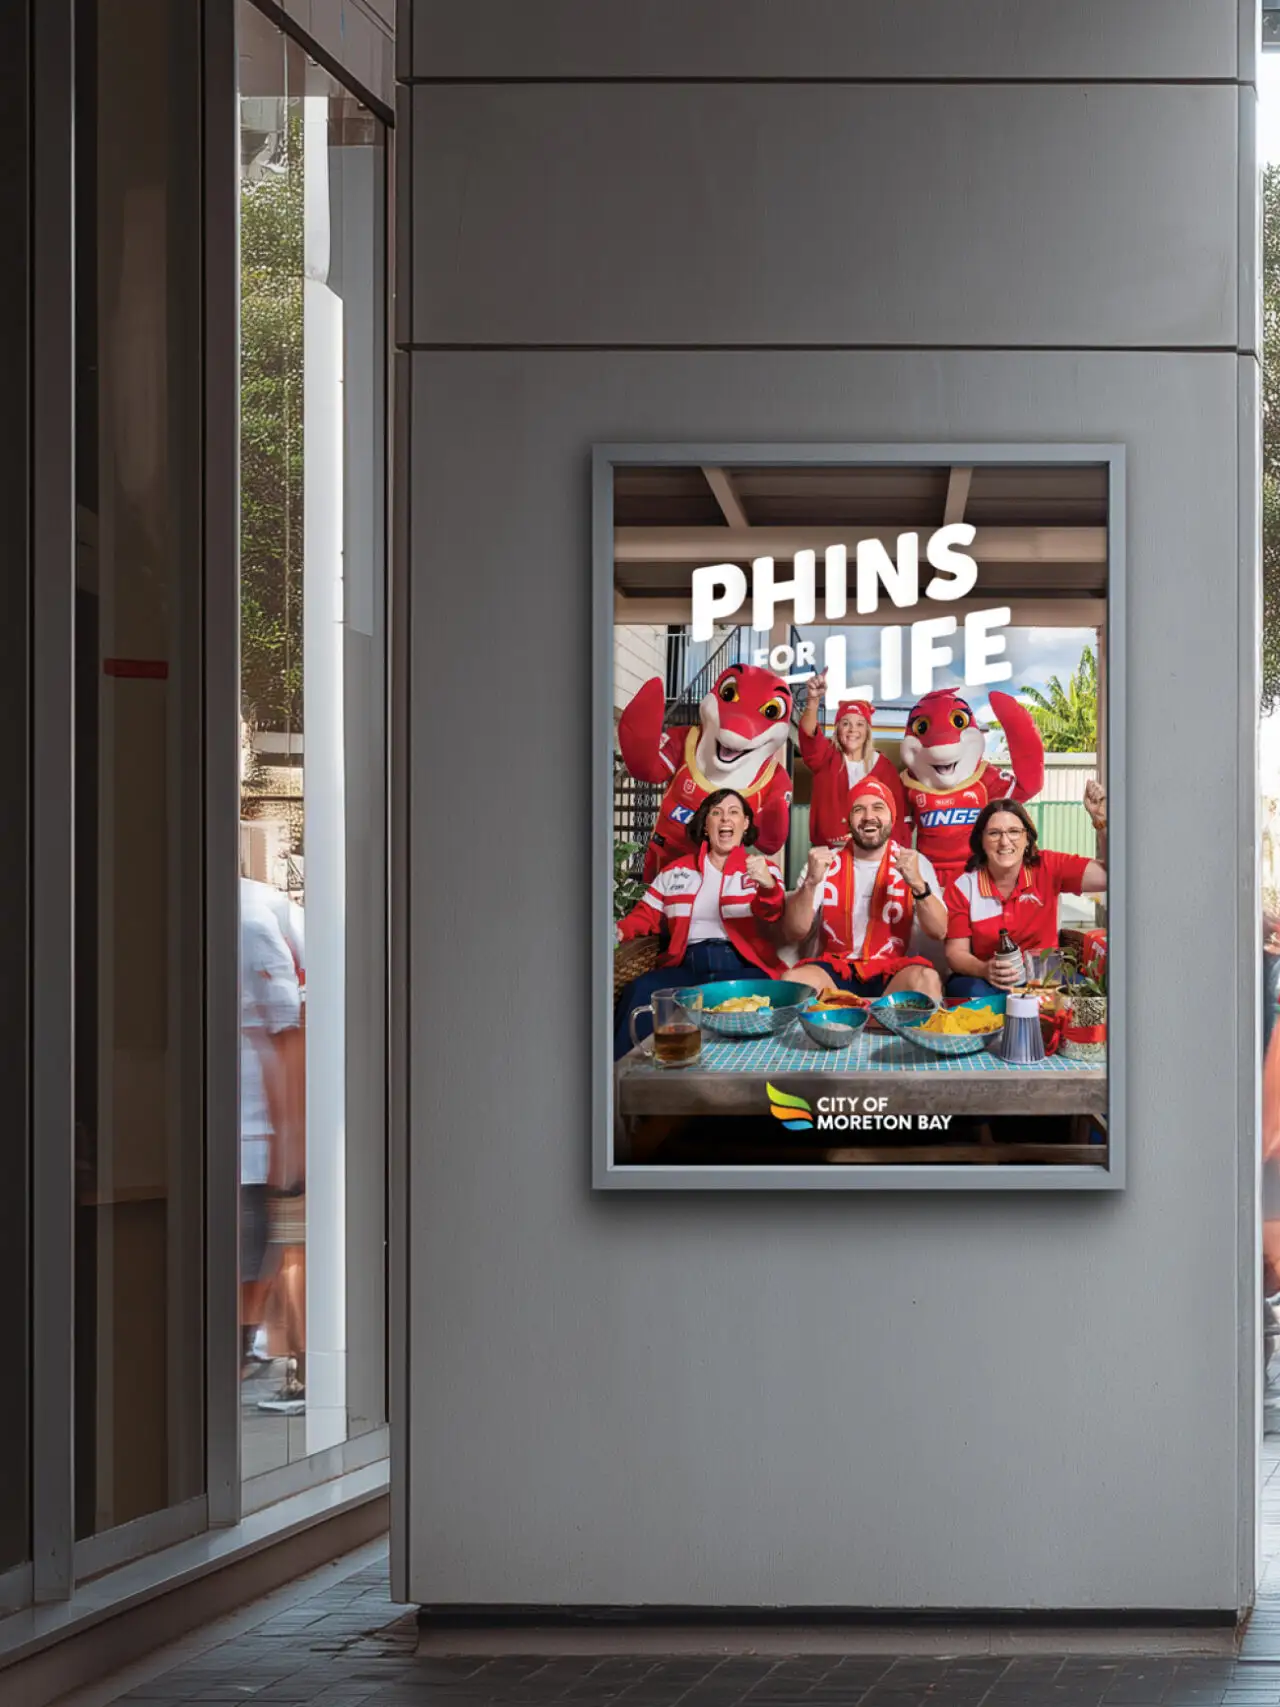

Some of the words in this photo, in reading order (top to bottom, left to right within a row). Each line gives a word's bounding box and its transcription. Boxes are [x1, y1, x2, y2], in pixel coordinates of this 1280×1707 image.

[692, 523, 978, 643] PHINS
[753, 641, 816, 672] FOR
[825, 607, 1013, 711] LIFE
[816, 1096, 859, 1113] CITY
[863, 1096, 889, 1113] OF
[816, 1115, 913, 1131] MORETON
[918, 1115, 953, 1131] BAY
